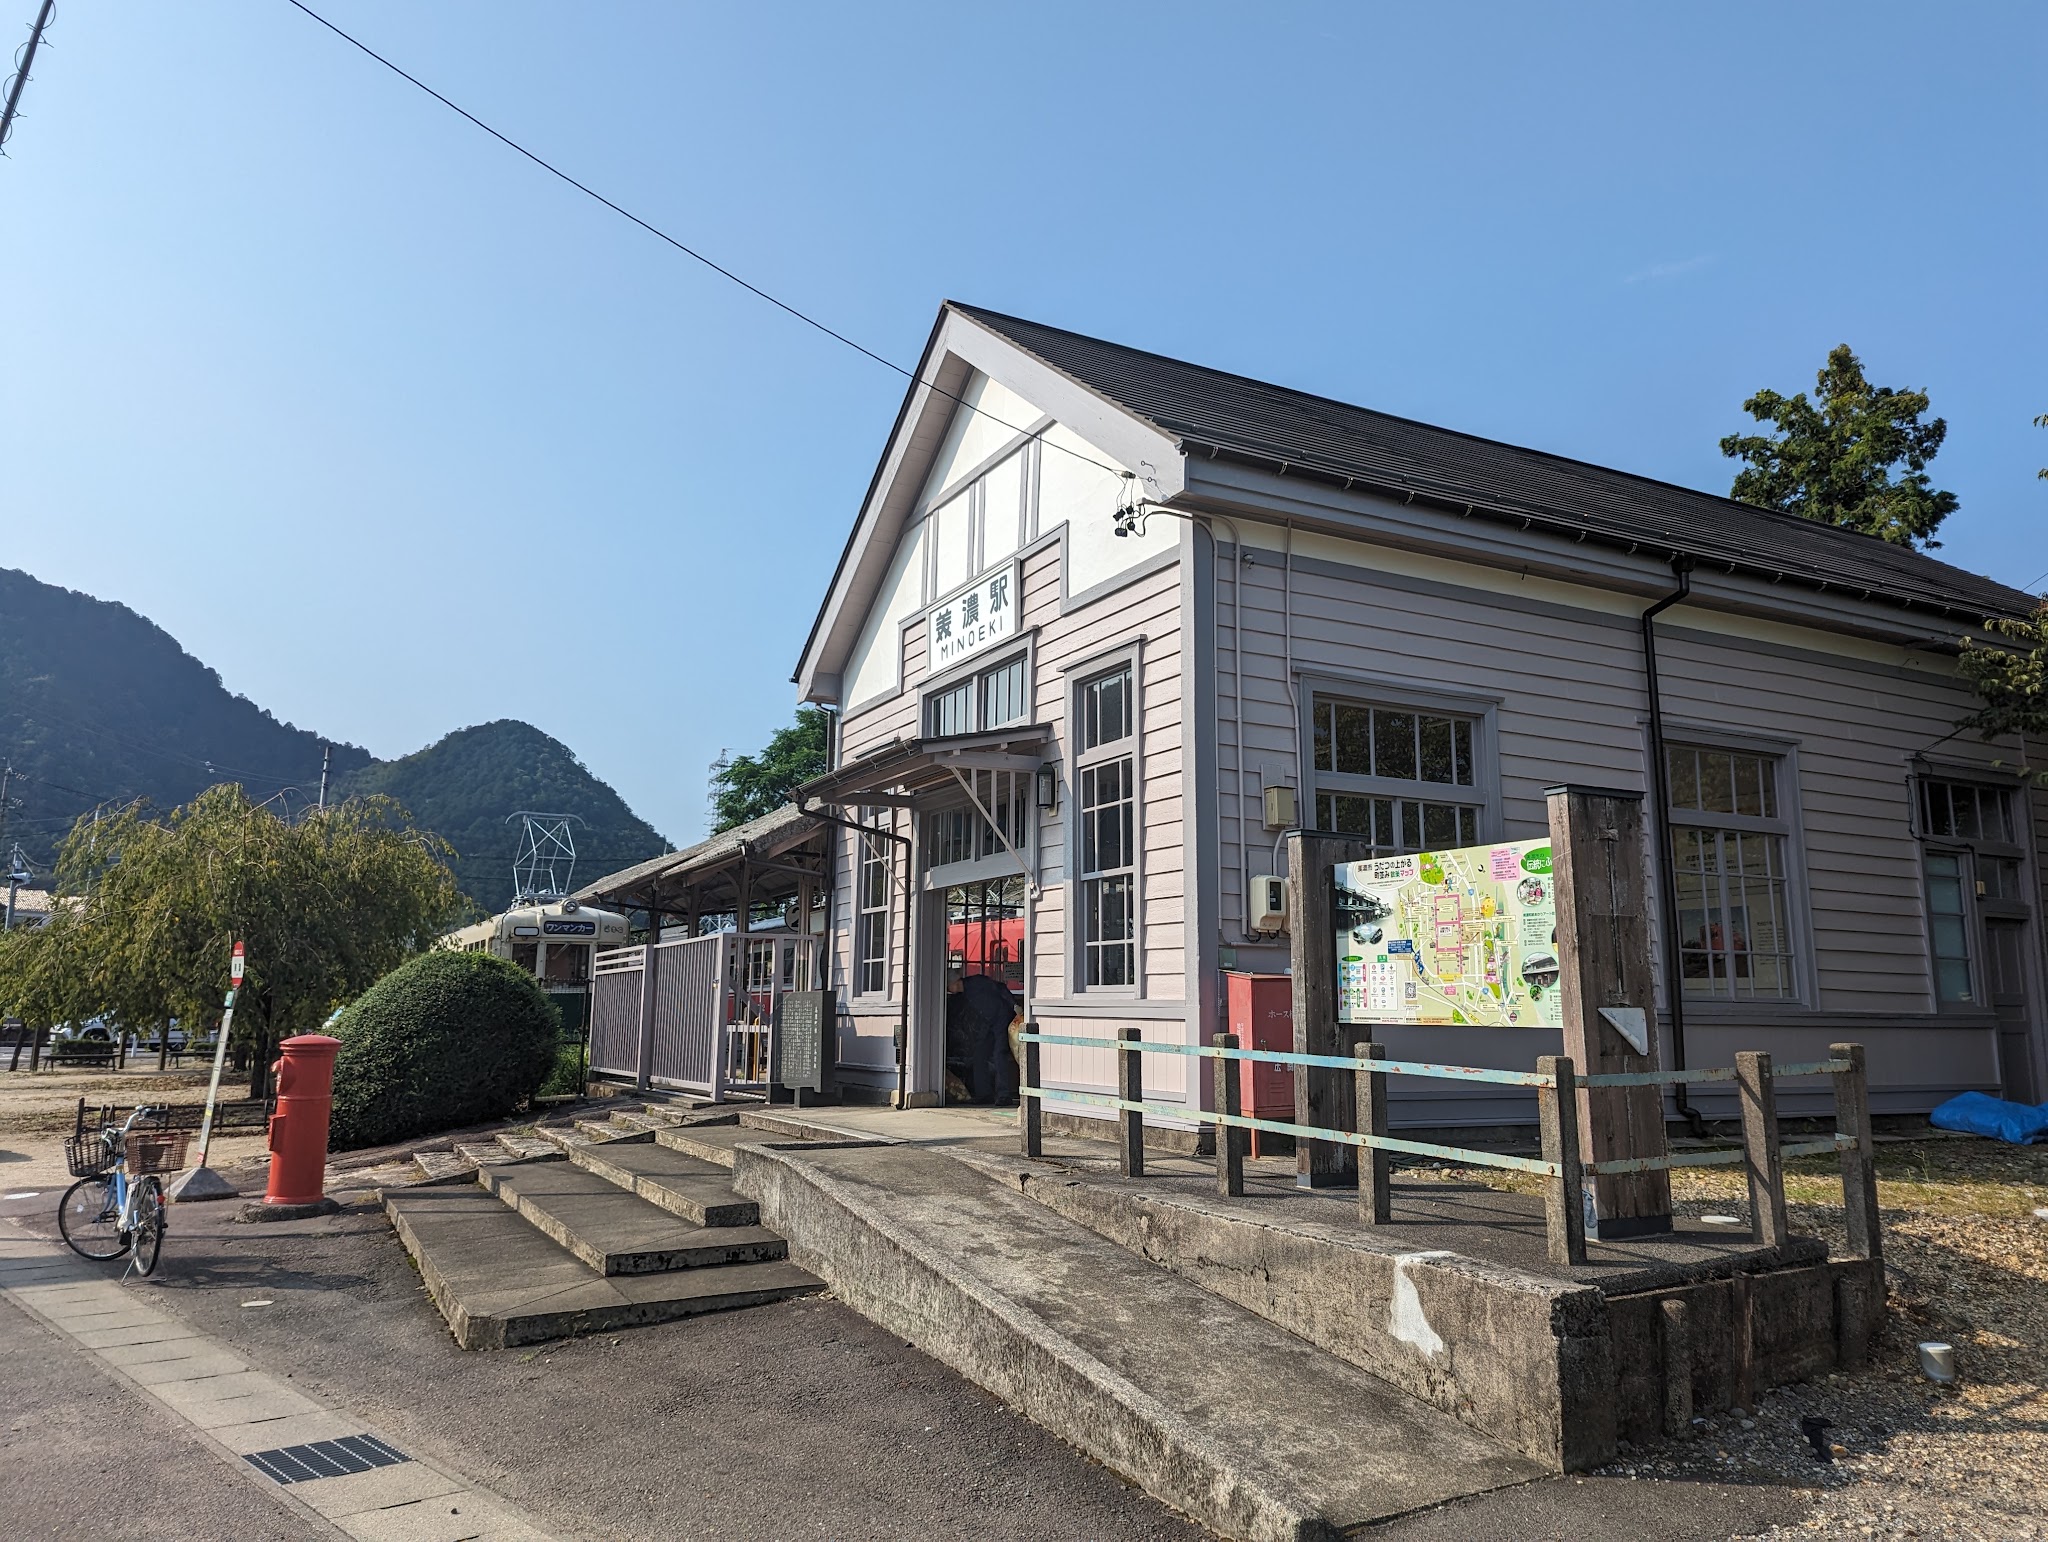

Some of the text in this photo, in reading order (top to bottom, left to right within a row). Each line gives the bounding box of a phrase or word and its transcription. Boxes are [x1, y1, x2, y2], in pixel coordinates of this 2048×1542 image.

[935, 574, 1009, 644] 美濃駅
[941, 615, 1003, 661] MINOEKI
[1374, 859, 1412, 871] うだつの上がる
[546, 923, 594, 932] ワンマンカー
